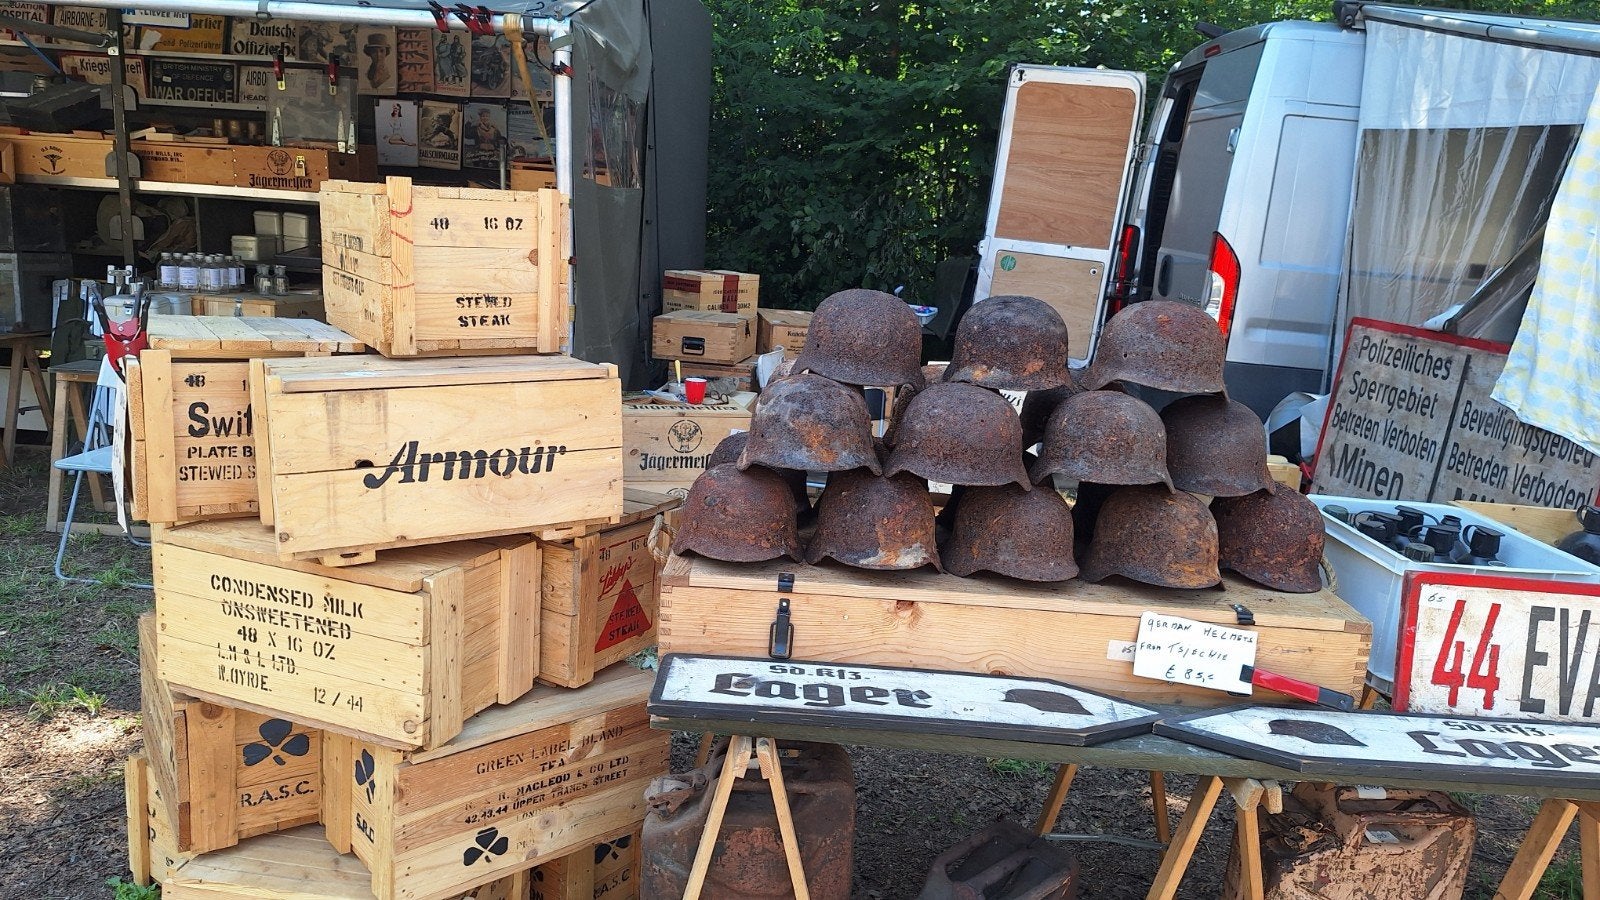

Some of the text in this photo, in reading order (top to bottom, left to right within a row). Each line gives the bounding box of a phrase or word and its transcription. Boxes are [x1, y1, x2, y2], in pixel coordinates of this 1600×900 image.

[0, 8, 44, 23] OSPITAL
[192, 17, 223, 29] artier
[162, 63, 223, 73] BRITISH MINISTRY
[153, 85, 234, 103] WAR OFFICE
[455, 292, 512, 309] STEWED
[457, 314, 511, 328] STEAK
[1357, 334, 1453, 382] Polizeiliches
[183, 373, 206, 388] 48
[1348, 370, 1439, 420] Sperrgebiet
[187, 445, 238, 459] PLATE
[1331, 402, 1437, 464] Betreten Verboten
[179, 464, 243, 482] STEWED
[363, 440, 567, 489] Armour
[1336, 443, 1404, 501] Minen
[1446, 442, 1508, 490] Betreden
[210, 573, 364, 619] CONDENSED MILK
[221, 598, 352, 640] UNSWEETENED
[1203, 627, 1254, 644] HELMETS
[237, 625, 336, 661] 48 X 16 OZ
[1431, 599, 1502, 711] 44
[708, 671, 933, 709] Lager
[476, 753, 524, 776] GREEN
[531, 738, 576, 761] LABEL
[1406, 730, 1600, 769] Lage
[240, 780, 315, 808] R.A.S.C.
[512, 793, 546, 811] UPPER
[592, 768, 628, 786] STREET
[516, 772, 571, 796] MACLEOD
[609, 755, 629, 769] LTD
